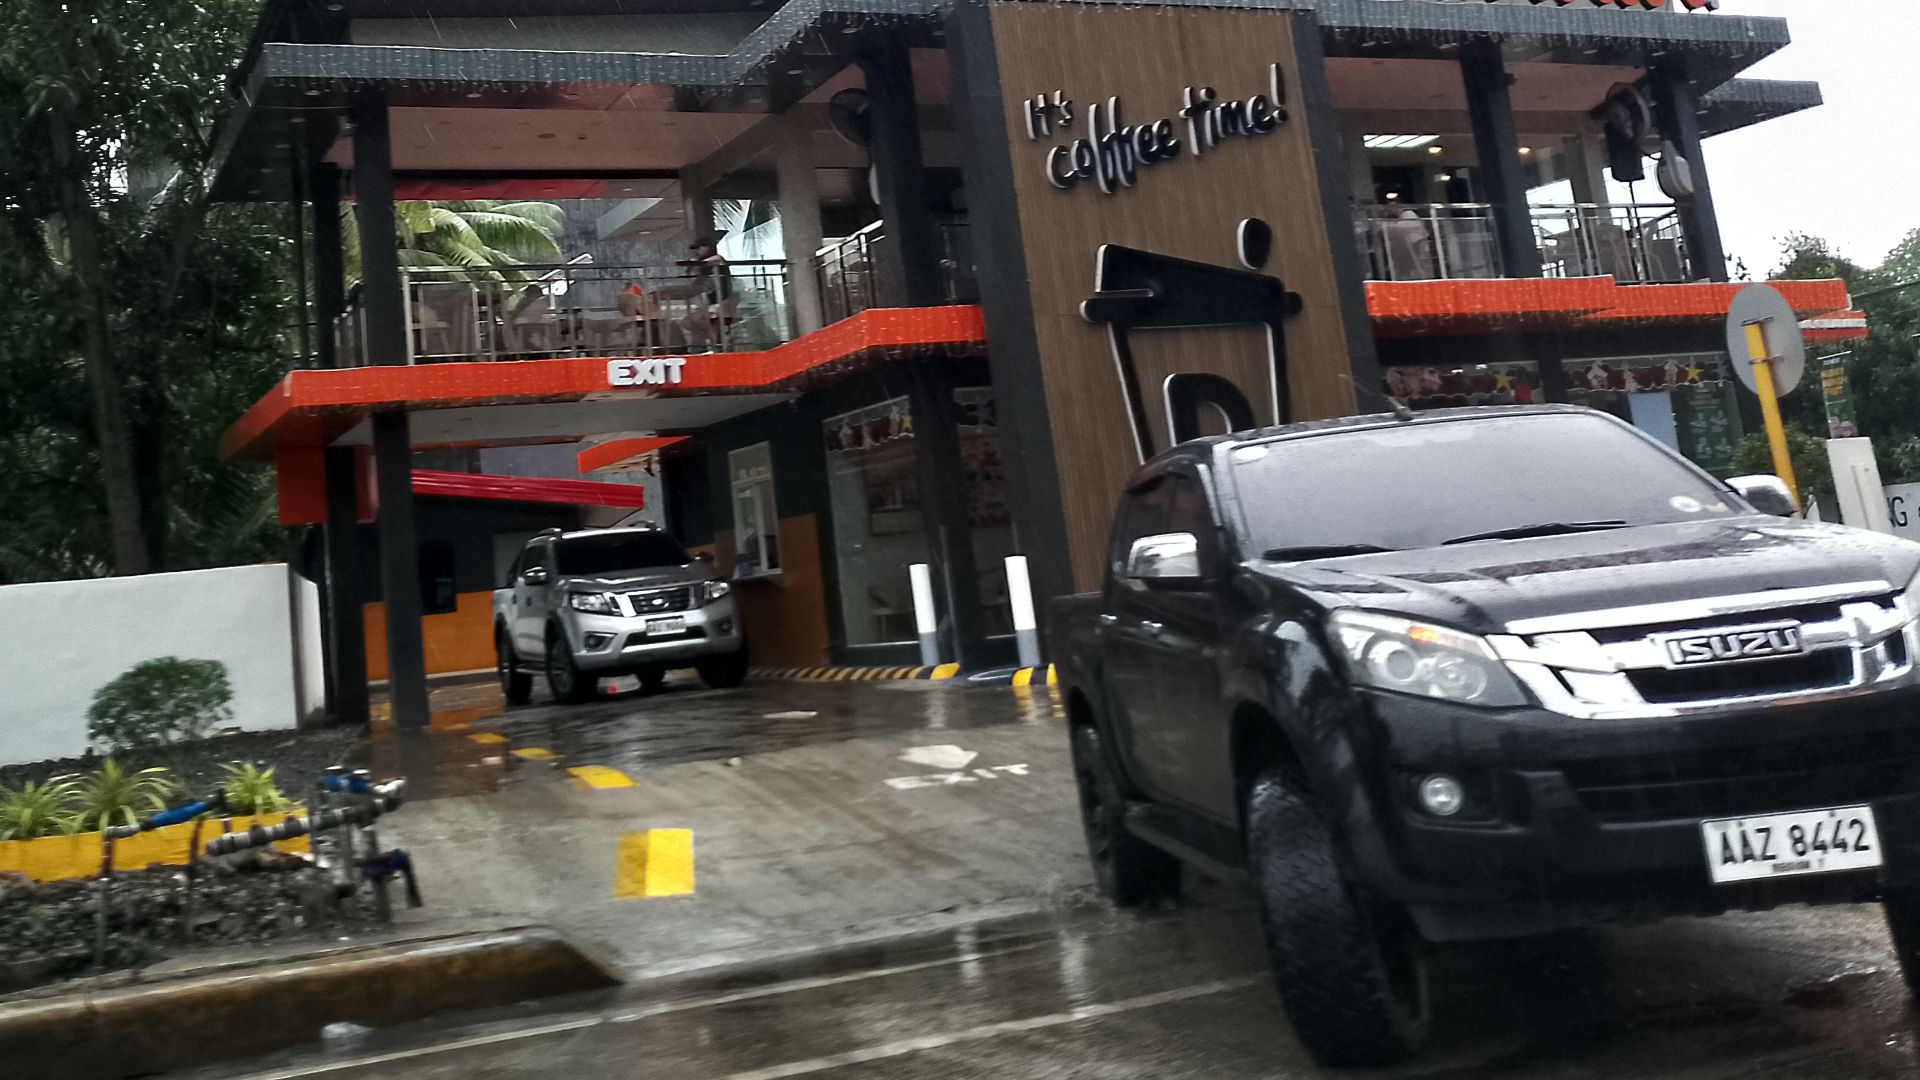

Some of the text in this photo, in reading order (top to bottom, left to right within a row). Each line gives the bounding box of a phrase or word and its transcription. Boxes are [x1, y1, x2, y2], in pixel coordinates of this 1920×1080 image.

[1023, 89, 1073, 140] It's
[1179, 62, 1289, 156] time!
[607, 358, 687, 386] EXIT
[1667, 627, 1799, 664] ISUZU
[1720, 818, 1870, 865] AAZ 8442
